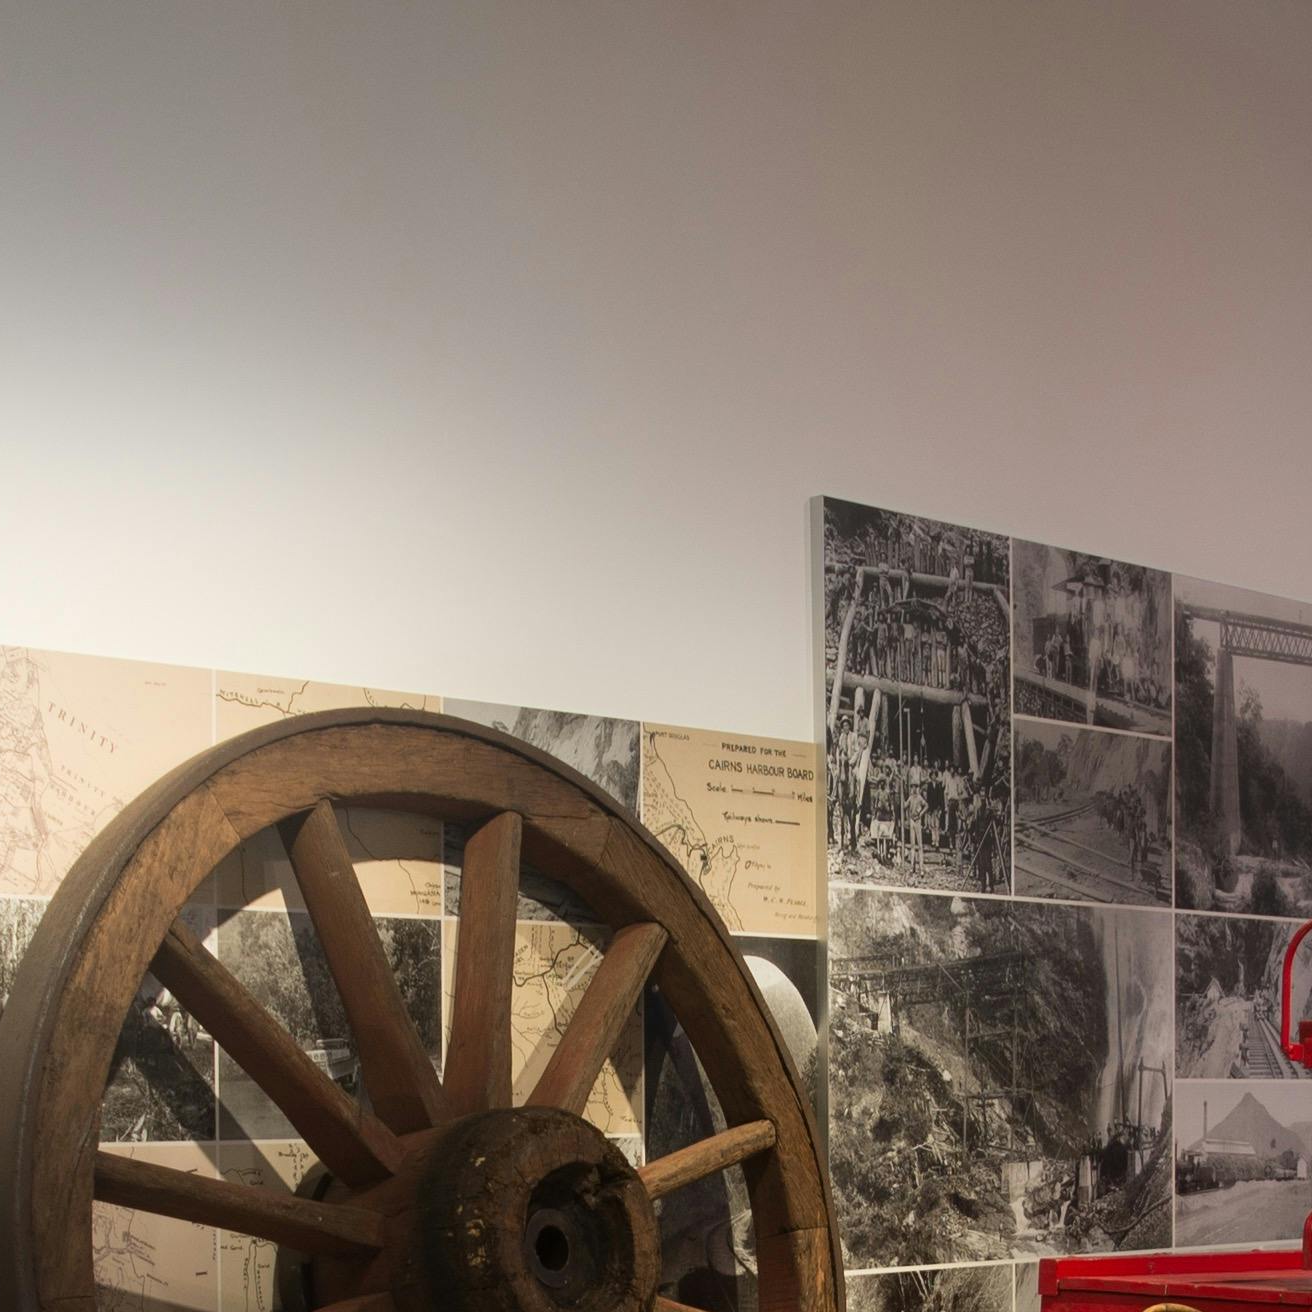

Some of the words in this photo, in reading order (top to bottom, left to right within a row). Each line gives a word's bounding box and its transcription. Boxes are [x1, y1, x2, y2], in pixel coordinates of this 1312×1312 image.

[48, 702, 116, 753] TRINITY
[721, 742, 756, 754] PREPARED
[760, 747, 773, 756] FOR
[773, 749, 786, 757] THE
[708, 759, 742, 773] CAIRNS
[746, 764, 785, 777] HARBOUR
[787, 767, 814, 781] BOARD
